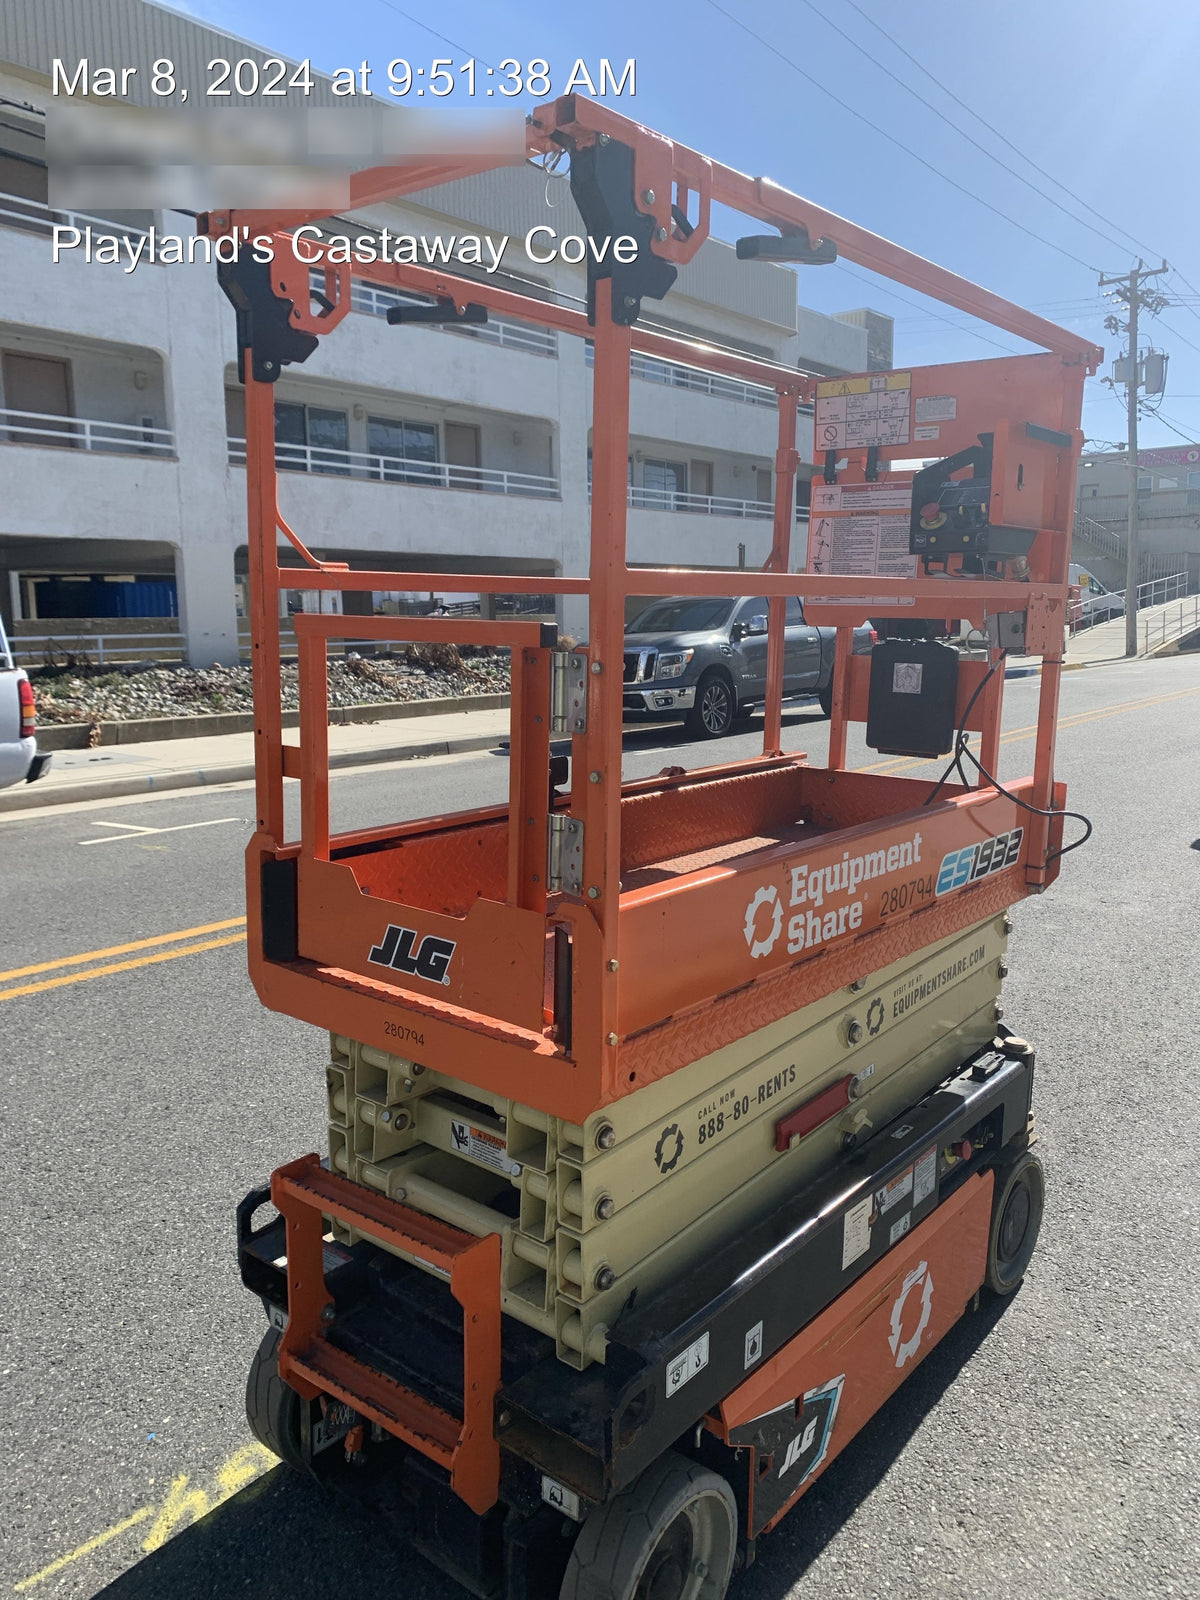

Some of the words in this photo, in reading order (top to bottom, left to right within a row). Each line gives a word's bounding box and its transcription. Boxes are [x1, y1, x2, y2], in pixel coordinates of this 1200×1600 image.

[789, 832, 922, 907] Equipment
[935, 827, 1024, 898] ES1932
[787, 901, 863, 955] Share
[880, 875, 933, 918] 280794
[367, 923, 457, 985] JLG
[893, 944, 985, 1018] EQUIPMENTSHARE.COM
[384, 1021, 425, 1047] 280794
[698, 1102, 717, 1120] CALL
[719, 1088, 736, 1105] NOW
[698, 1064, 797, 1145] 888-80-RENTS
[778, 1415, 818, 1480] JLG
